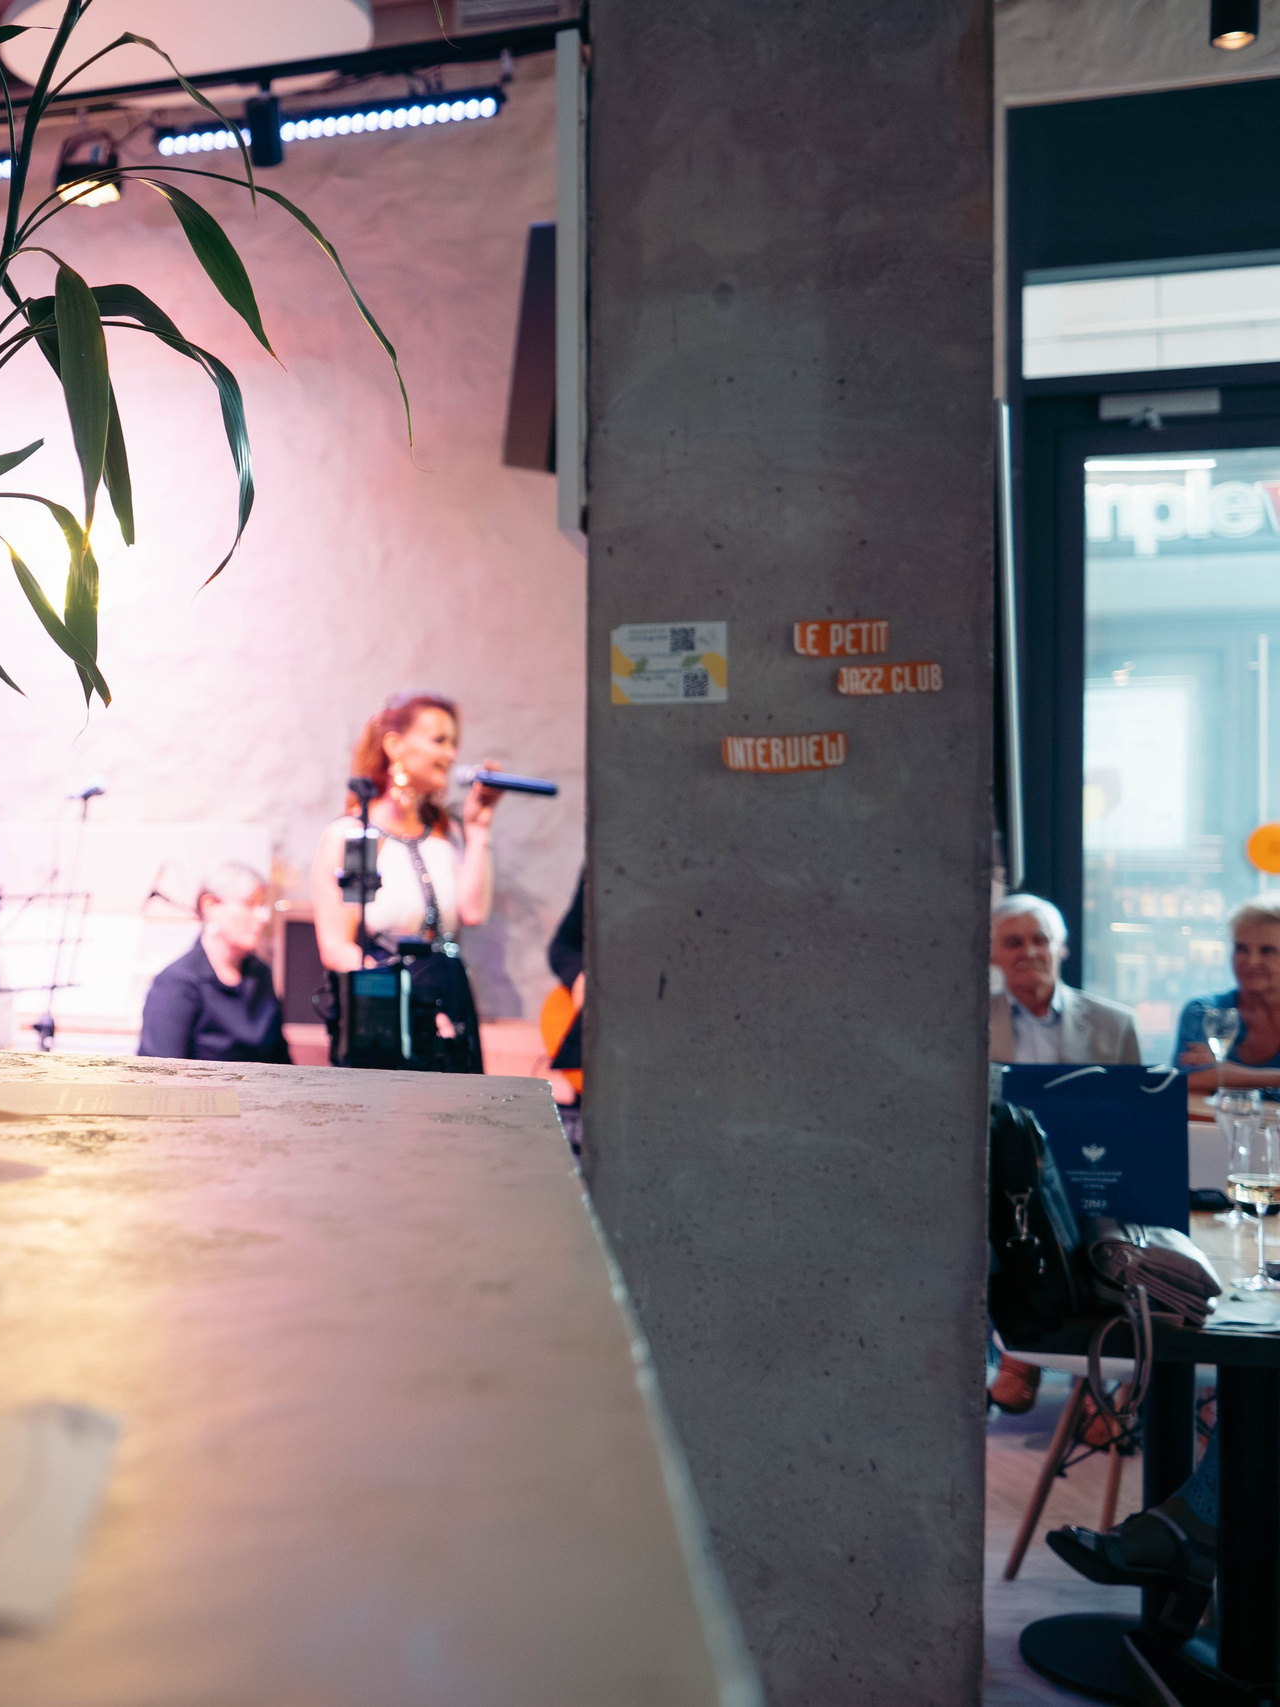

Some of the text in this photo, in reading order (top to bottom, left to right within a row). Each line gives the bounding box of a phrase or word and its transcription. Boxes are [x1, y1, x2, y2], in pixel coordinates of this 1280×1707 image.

[793, 620, 889, 655] LE PETIT
[838, 663, 943, 695] JAZZ CLUB
[727, 733, 845, 770] INTERVIEW
